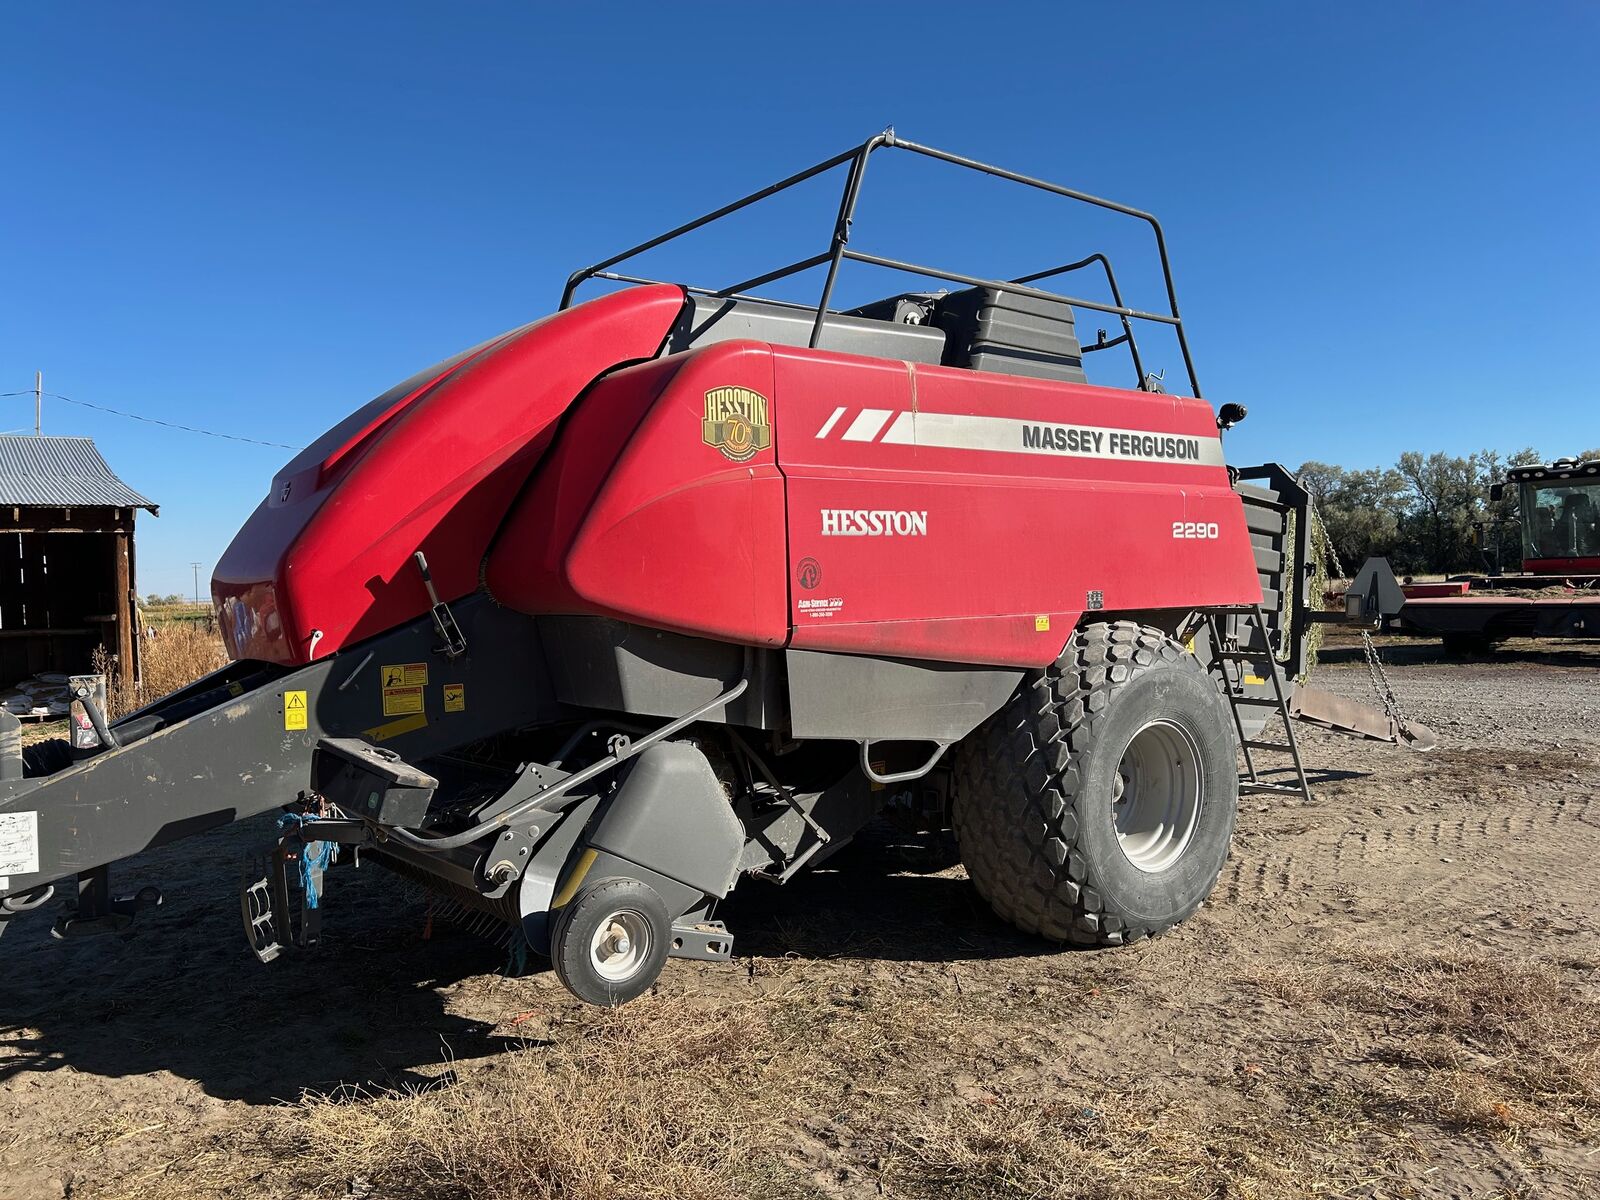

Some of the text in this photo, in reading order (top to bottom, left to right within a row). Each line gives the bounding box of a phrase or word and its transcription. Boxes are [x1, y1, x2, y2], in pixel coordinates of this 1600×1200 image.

[706, 388, 766, 427] HESSTON
[1022, 424, 1199, 460] MASSEY FERGUSON
[820, 509, 928, 536] HESSTON
[1172, 522, 1219, 539] 2290
